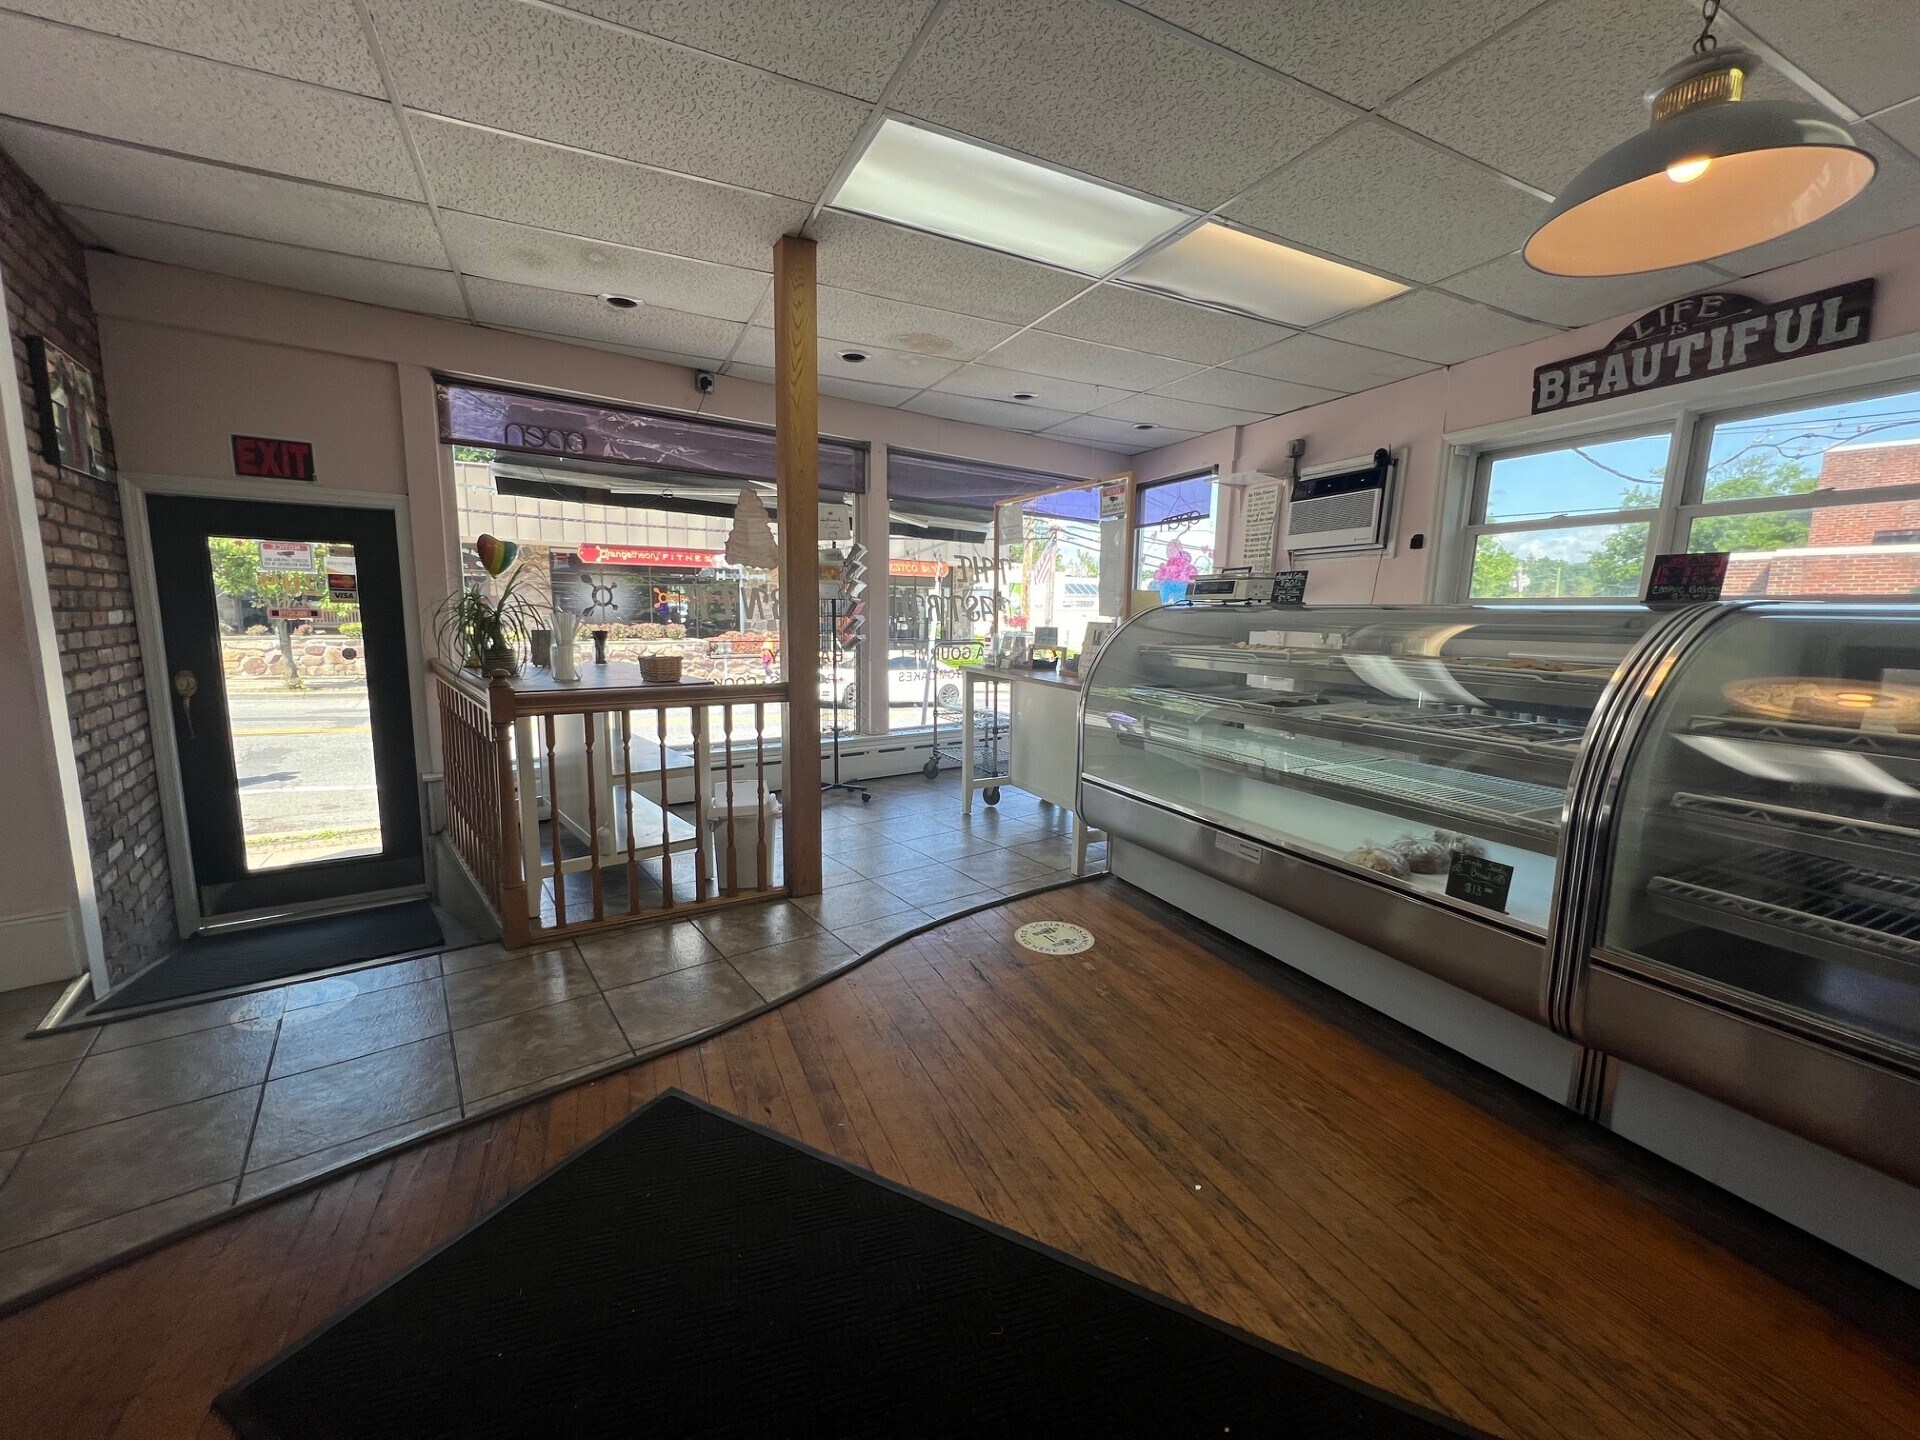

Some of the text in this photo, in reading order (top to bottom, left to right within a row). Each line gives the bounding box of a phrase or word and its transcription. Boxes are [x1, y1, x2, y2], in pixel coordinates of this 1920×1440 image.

[1632, 295, 1726, 340] LIFE
[1670, 322, 1688, 335] IS
[1536, 295, 1862, 410] BEAUTIFUL
[235, 436, 309, 479] EXIT
[662, 553, 713, 563] FITNES
